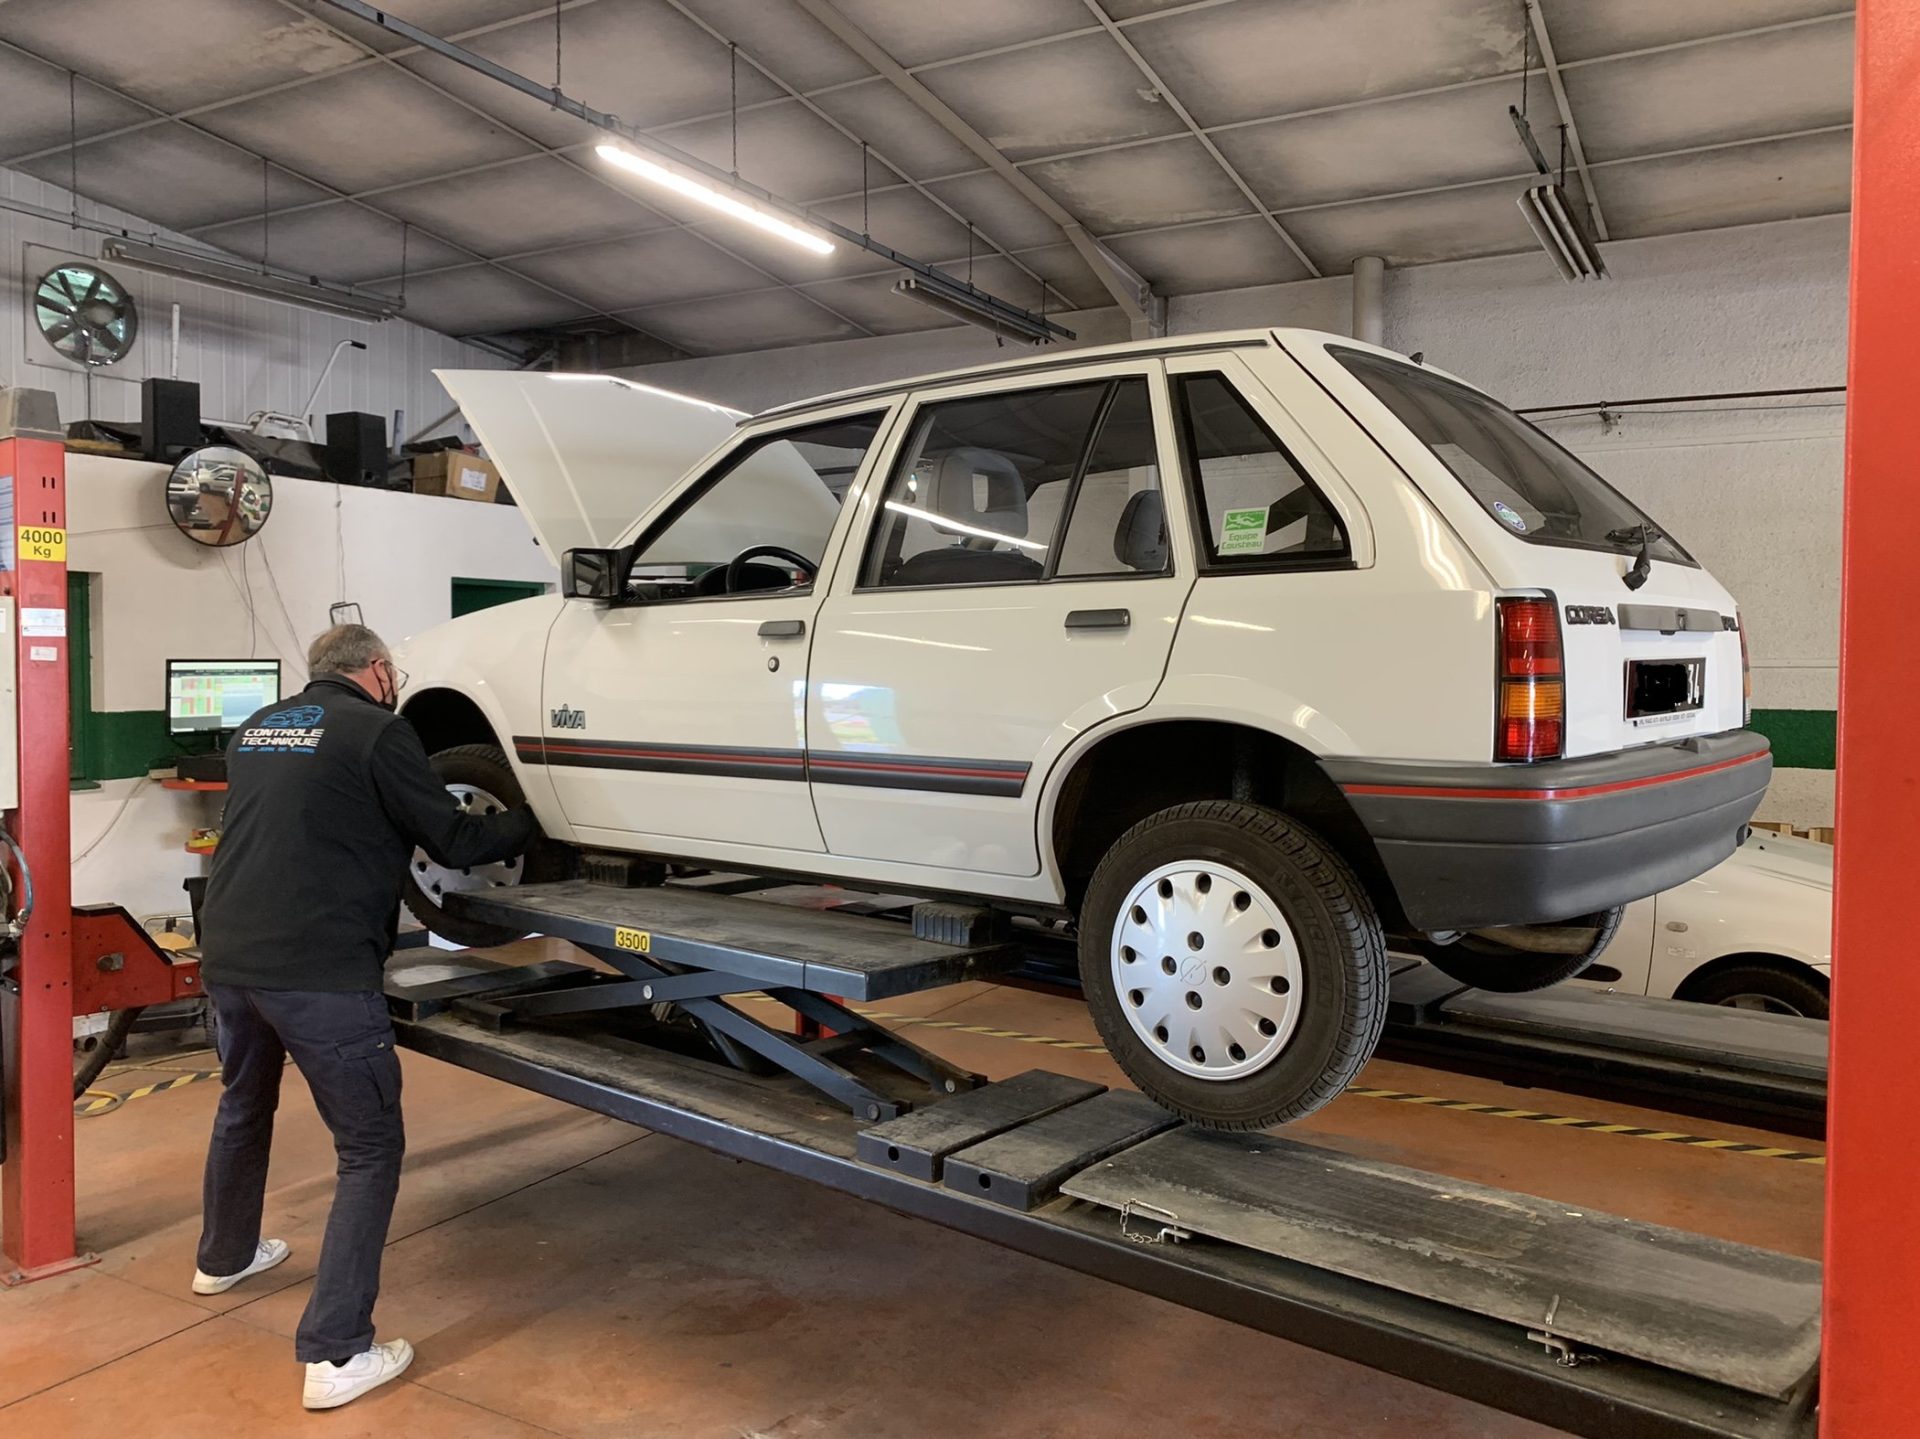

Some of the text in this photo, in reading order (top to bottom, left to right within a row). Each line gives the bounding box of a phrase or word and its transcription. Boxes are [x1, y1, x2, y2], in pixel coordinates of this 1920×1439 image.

[21, 530, 63, 545] 4000
[33, 545, 52, 559] Kg
[1565, 605, 1616, 625] CORSA
[244, 728, 325, 738] CONTROLE
[242, 737, 320, 748] TECHNIQUE
[617, 930, 648, 951] 3500
